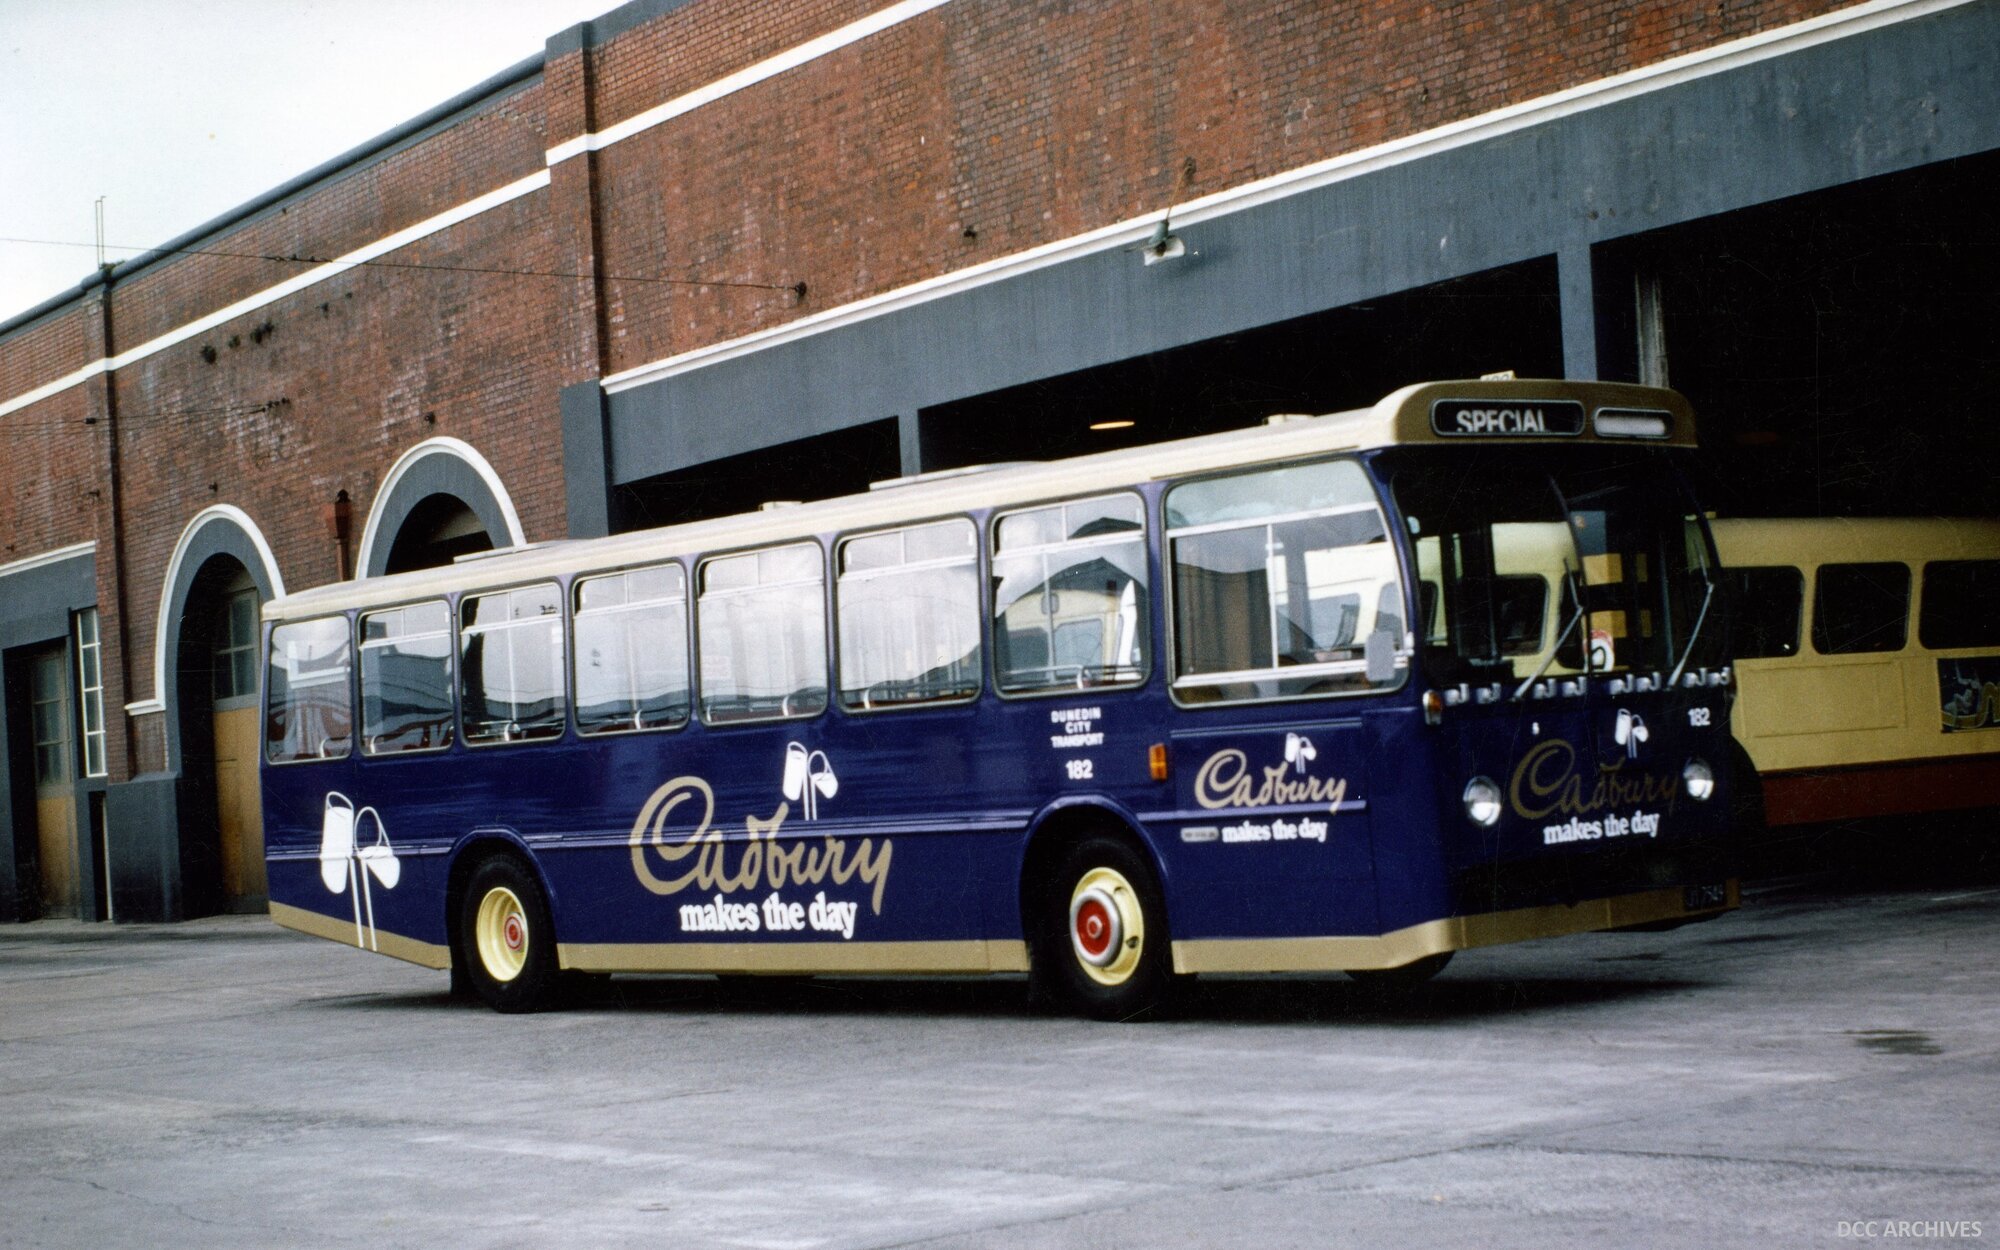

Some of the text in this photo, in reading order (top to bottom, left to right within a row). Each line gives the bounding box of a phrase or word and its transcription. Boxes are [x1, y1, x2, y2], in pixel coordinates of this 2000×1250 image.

[1455, 408, 1548, 433] SPECIAL
[1051, 707, 1101, 723] DUNEDIN
[1065, 721, 1091, 734] CITY
[1687, 708, 1711, 727] 182
[1051, 732, 1104, 748] TRANSPORT
[1065, 759, 1093, 779] 182
[1194, 748, 1347, 815] Cadbury
[1510, 738, 1680, 820] Cadbury
[1222, 817, 1328, 843] makes the day
[1543, 810, 1660, 845] makes the day
[628, 775, 893, 916] Cadbury
[679, 891, 858, 940] makes the day
